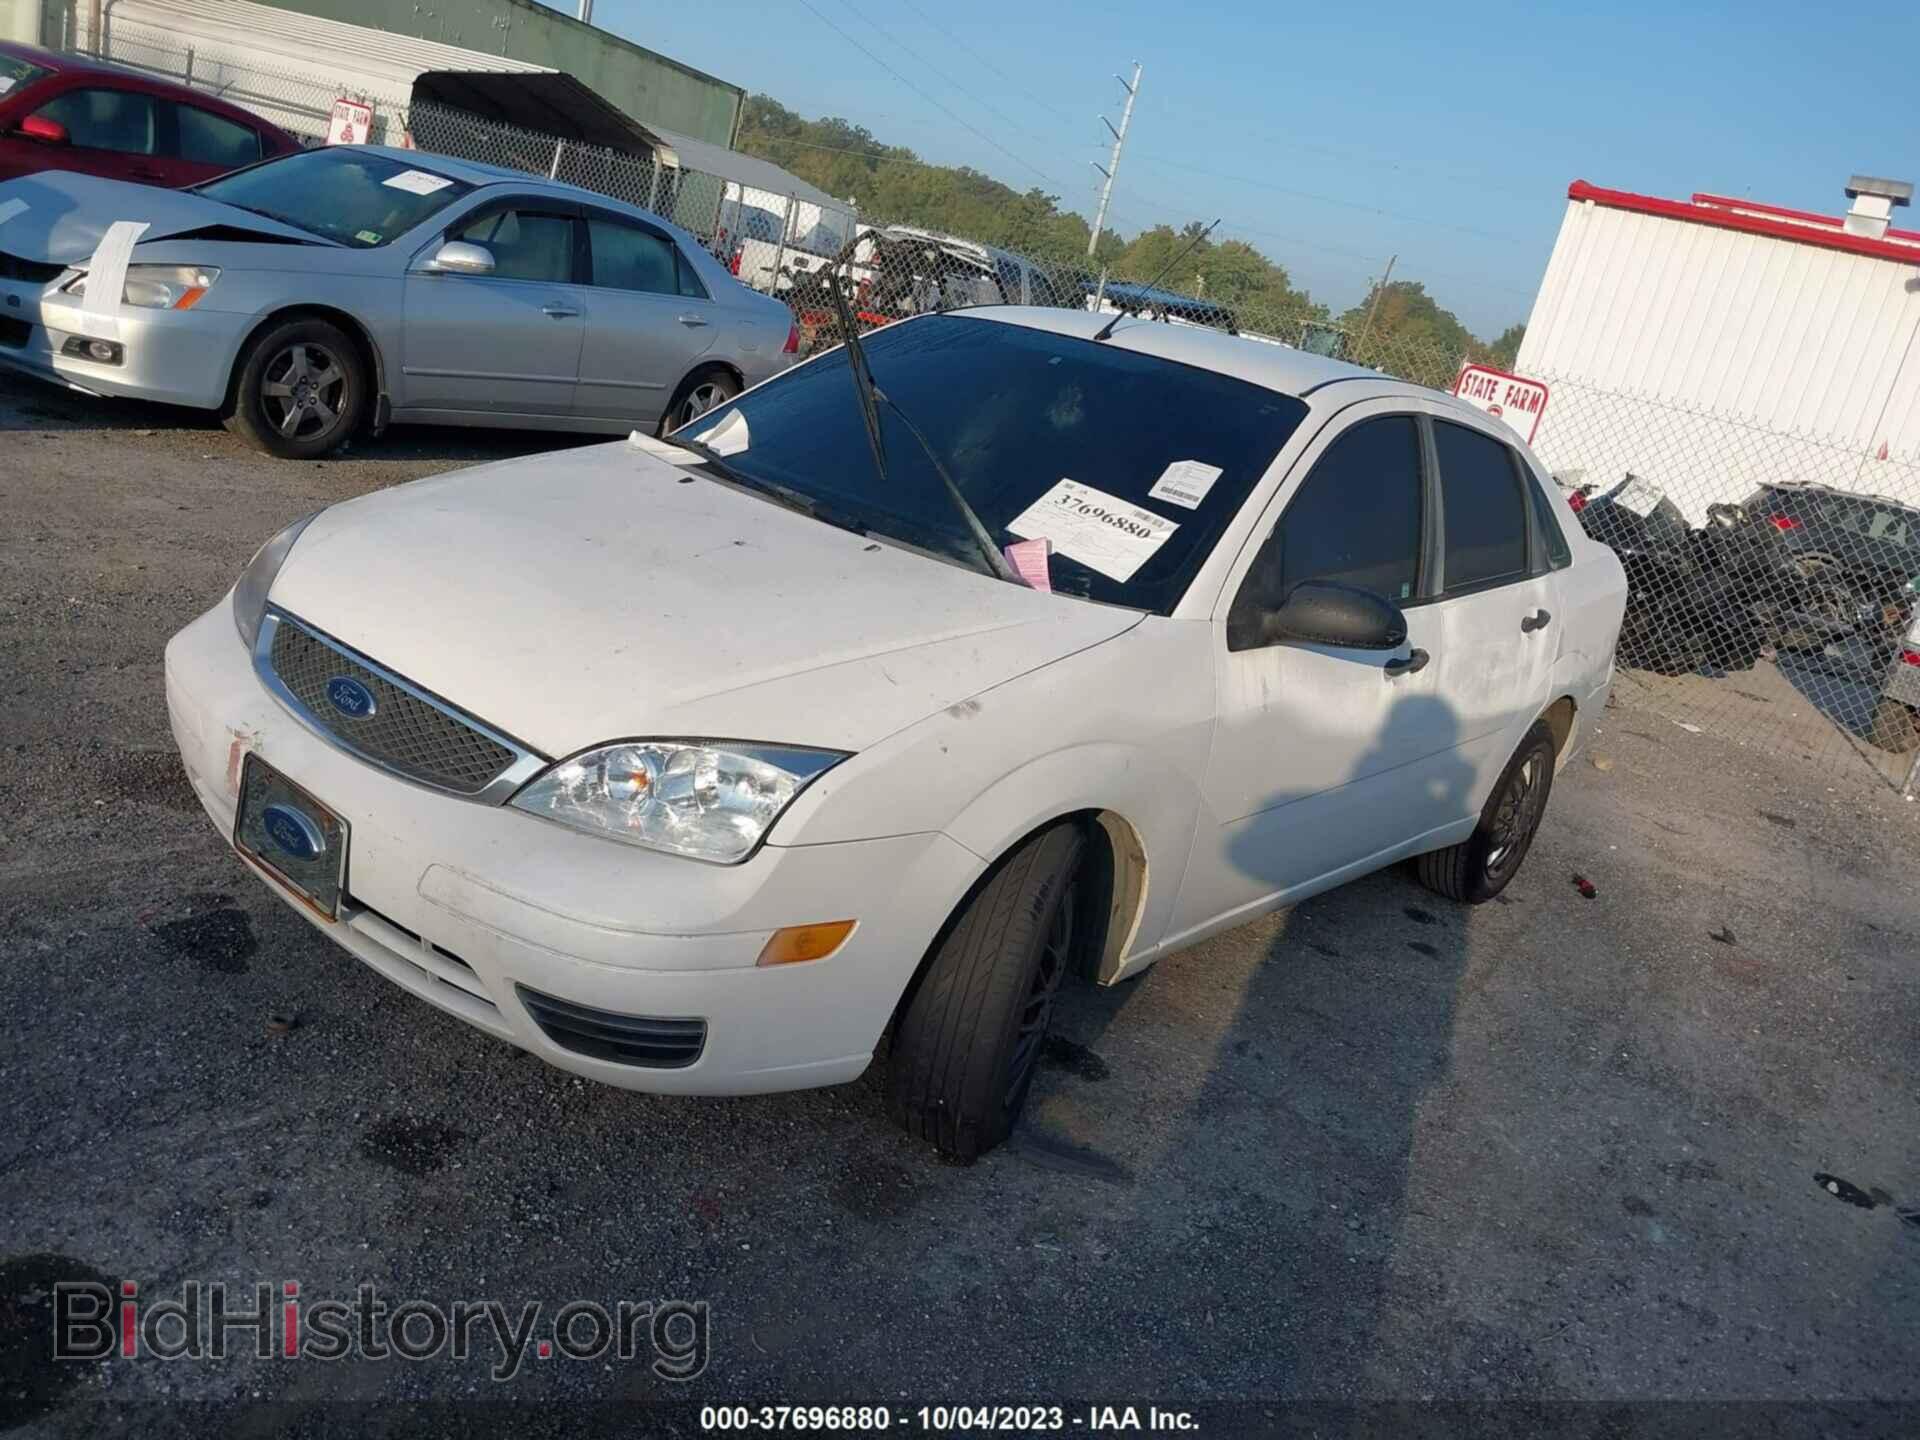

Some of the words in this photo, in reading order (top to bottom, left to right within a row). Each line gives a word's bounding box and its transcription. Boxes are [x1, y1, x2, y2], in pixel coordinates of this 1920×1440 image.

[1462, 373, 1499, 401] STATE
[1503, 384, 1542, 414] FARM
[1054, 493, 1151, 539] 37696880
[334, 684, 362, 710] Ford
